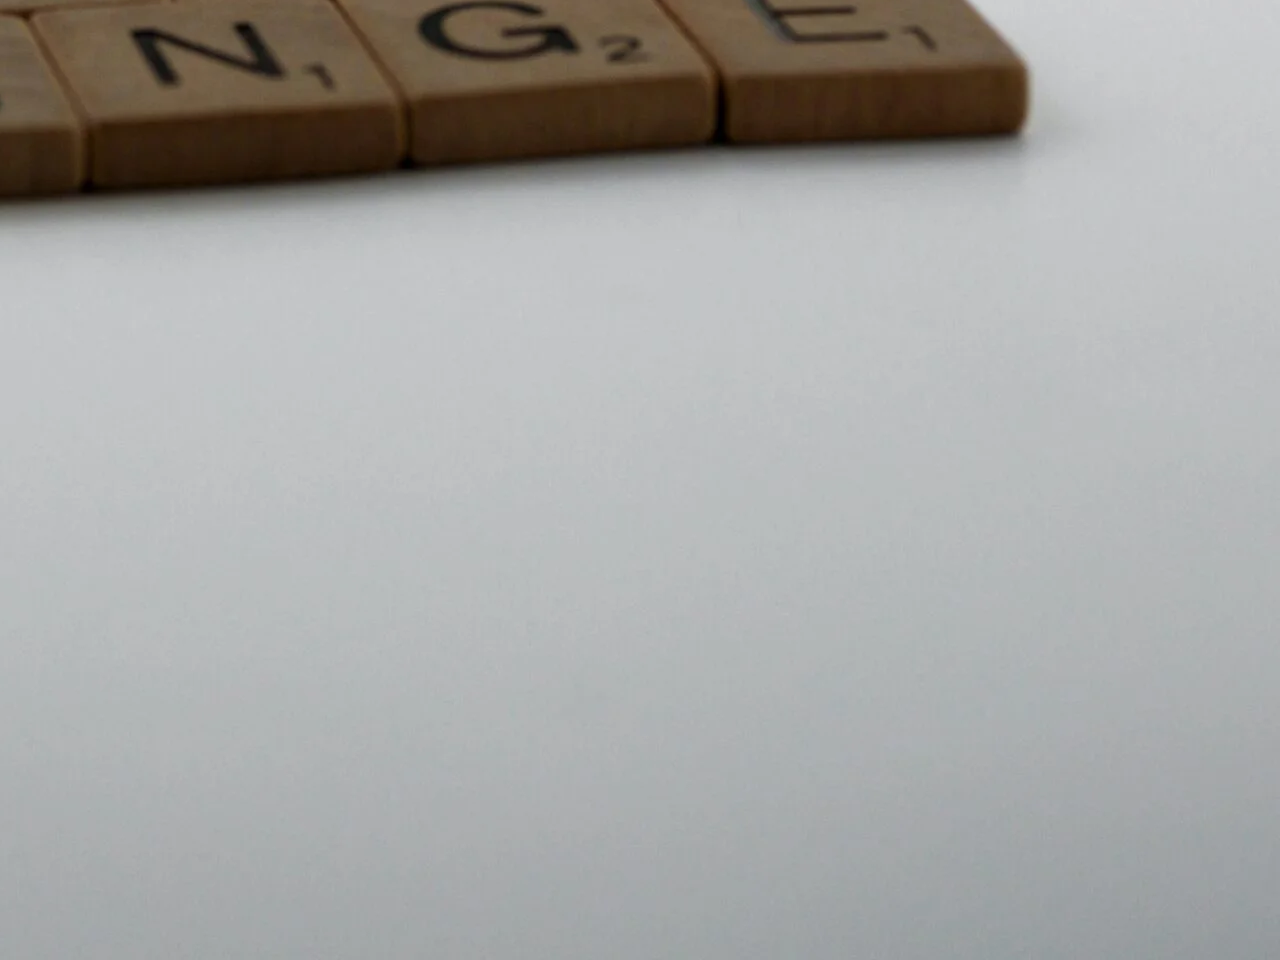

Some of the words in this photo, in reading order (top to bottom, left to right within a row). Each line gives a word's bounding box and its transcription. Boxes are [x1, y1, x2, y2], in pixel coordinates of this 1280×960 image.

[598, 35, 647, 65] 2
[901, 24, 939, 53] 1
[302, 64, 335, 92] 1
